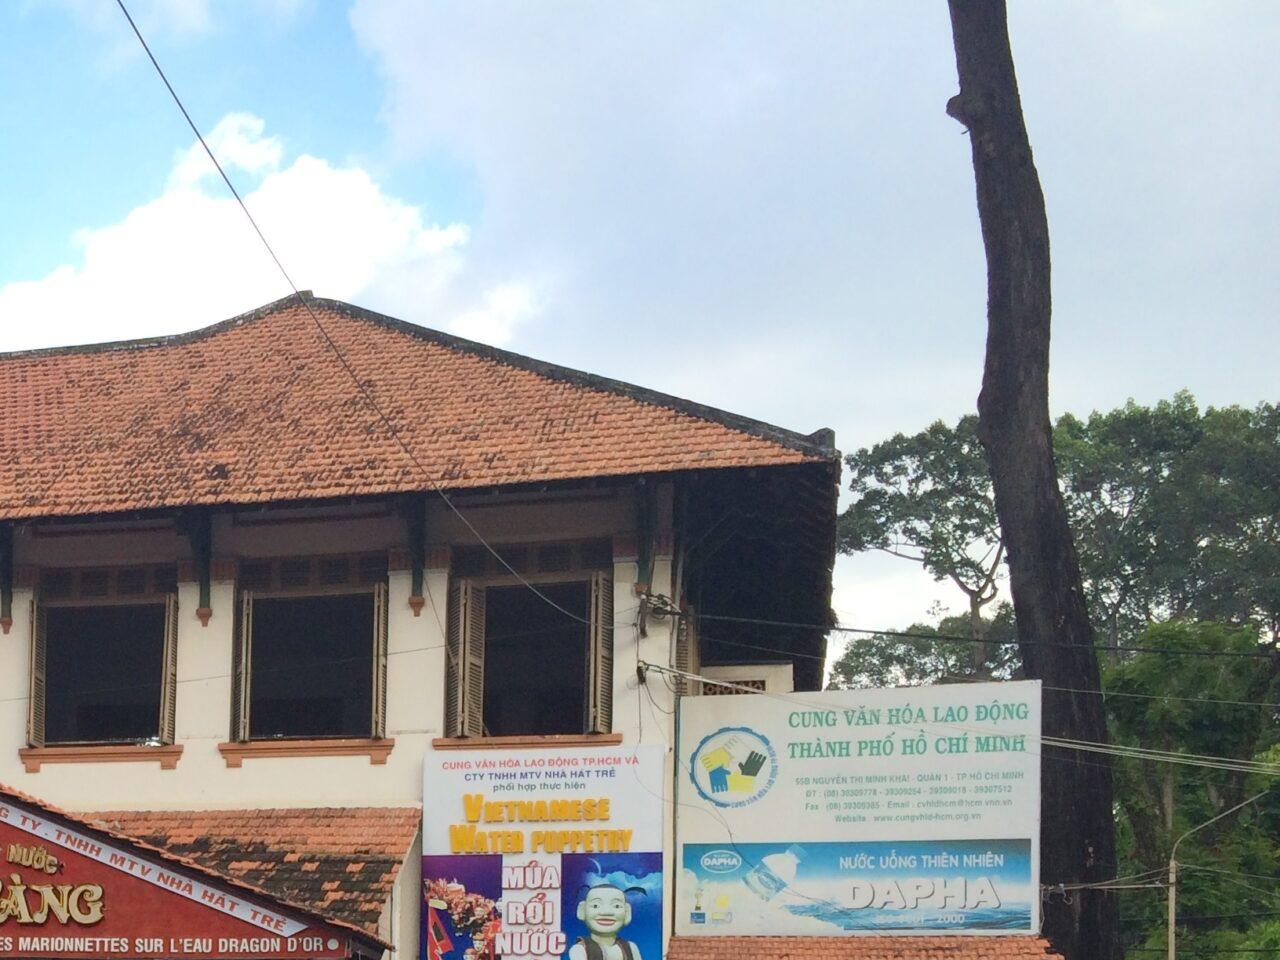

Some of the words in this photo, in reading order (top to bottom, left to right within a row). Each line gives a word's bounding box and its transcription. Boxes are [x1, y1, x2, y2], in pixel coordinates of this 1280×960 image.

[788, 710, 837, 728] CUNG
[843, 705, 881, 726] VĂN
[887, 703, 927, 725] HÓA
[932, 705, 969, 723] LAO
[975, 699, 1029, 725] ĐỘNG
[787, 737, 851, 759] THÀNH
[857, 731, 896, 757] PHỐ
[901, 729, 927, 756] HỒ
[934, 732, 968, 755] CHÍ
[975, 735, 1026, 753] MINH
[442, 761, 472, 771] CUNG
[524, 758, 545, 768] LAO
[464, 772, 485, 782] CTY
[488, 772, 517, 781] TNHH
[520, 770, 541, 780] MTV
[518, 783, 537, 793] hợp
[7, 842, 60, 875] NƯỚC
[704, 857, 738, 866] DAPHA
[839, 853, 875, 869] NƯỚC
[880, 850, 917, 869] UỐNG
[922, 851, 960, 868] THIÊN
[963, 851, 1004, 868] NHIÊN
[20, 814, 43, 832] TY
[55, 829, 103, 857] TNHH
[109, 853, 153, 878] MTV
[156, 870, 194, 896] NHÀ
[201, 888, 240, 913] HÁT
[250, 908, 289, 933] TRẺ
[502, 860, 561, 890] MÚA
[845, 875, 1002, 910] DAPHA
[507, 893, 554, 926] RỐI
[19, 937, 129, 953] MARIONNETTES
[135, 937, 164, 953] SUR
[170, 937, 212, 953] L'EAU
[218, 937, 281, 953] DRAGON
